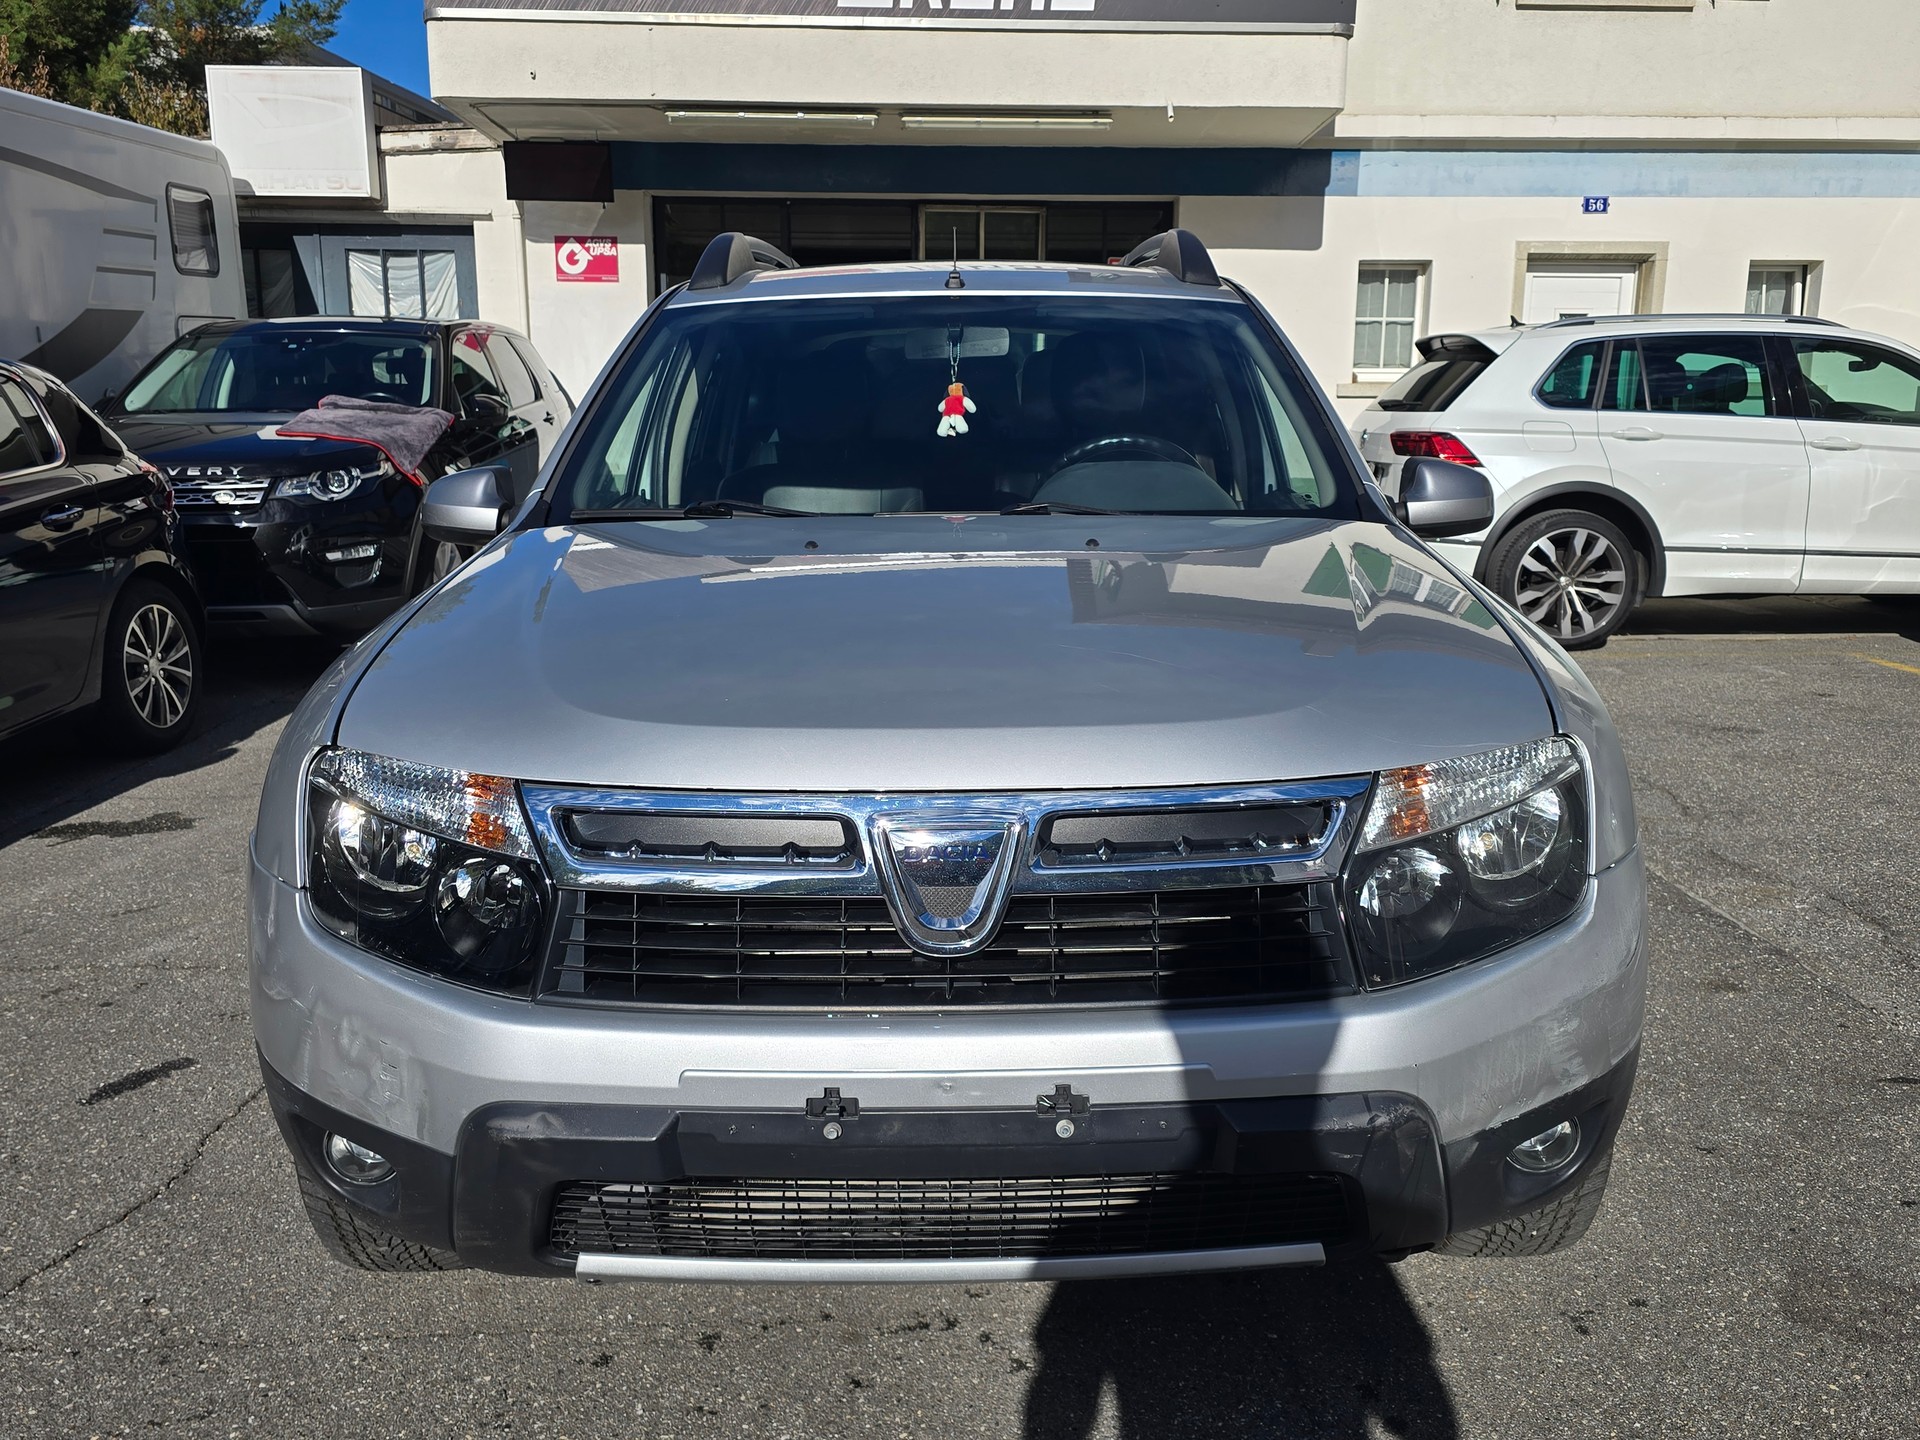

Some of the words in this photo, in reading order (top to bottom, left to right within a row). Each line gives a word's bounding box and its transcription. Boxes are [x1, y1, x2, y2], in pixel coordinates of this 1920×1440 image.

[1588, 199, 1604, 211] 56
[585, 238, 611, 248] AGVS
[590, 246, 617, 256] UPSA
[904, 845, 990, 862] DACIA
